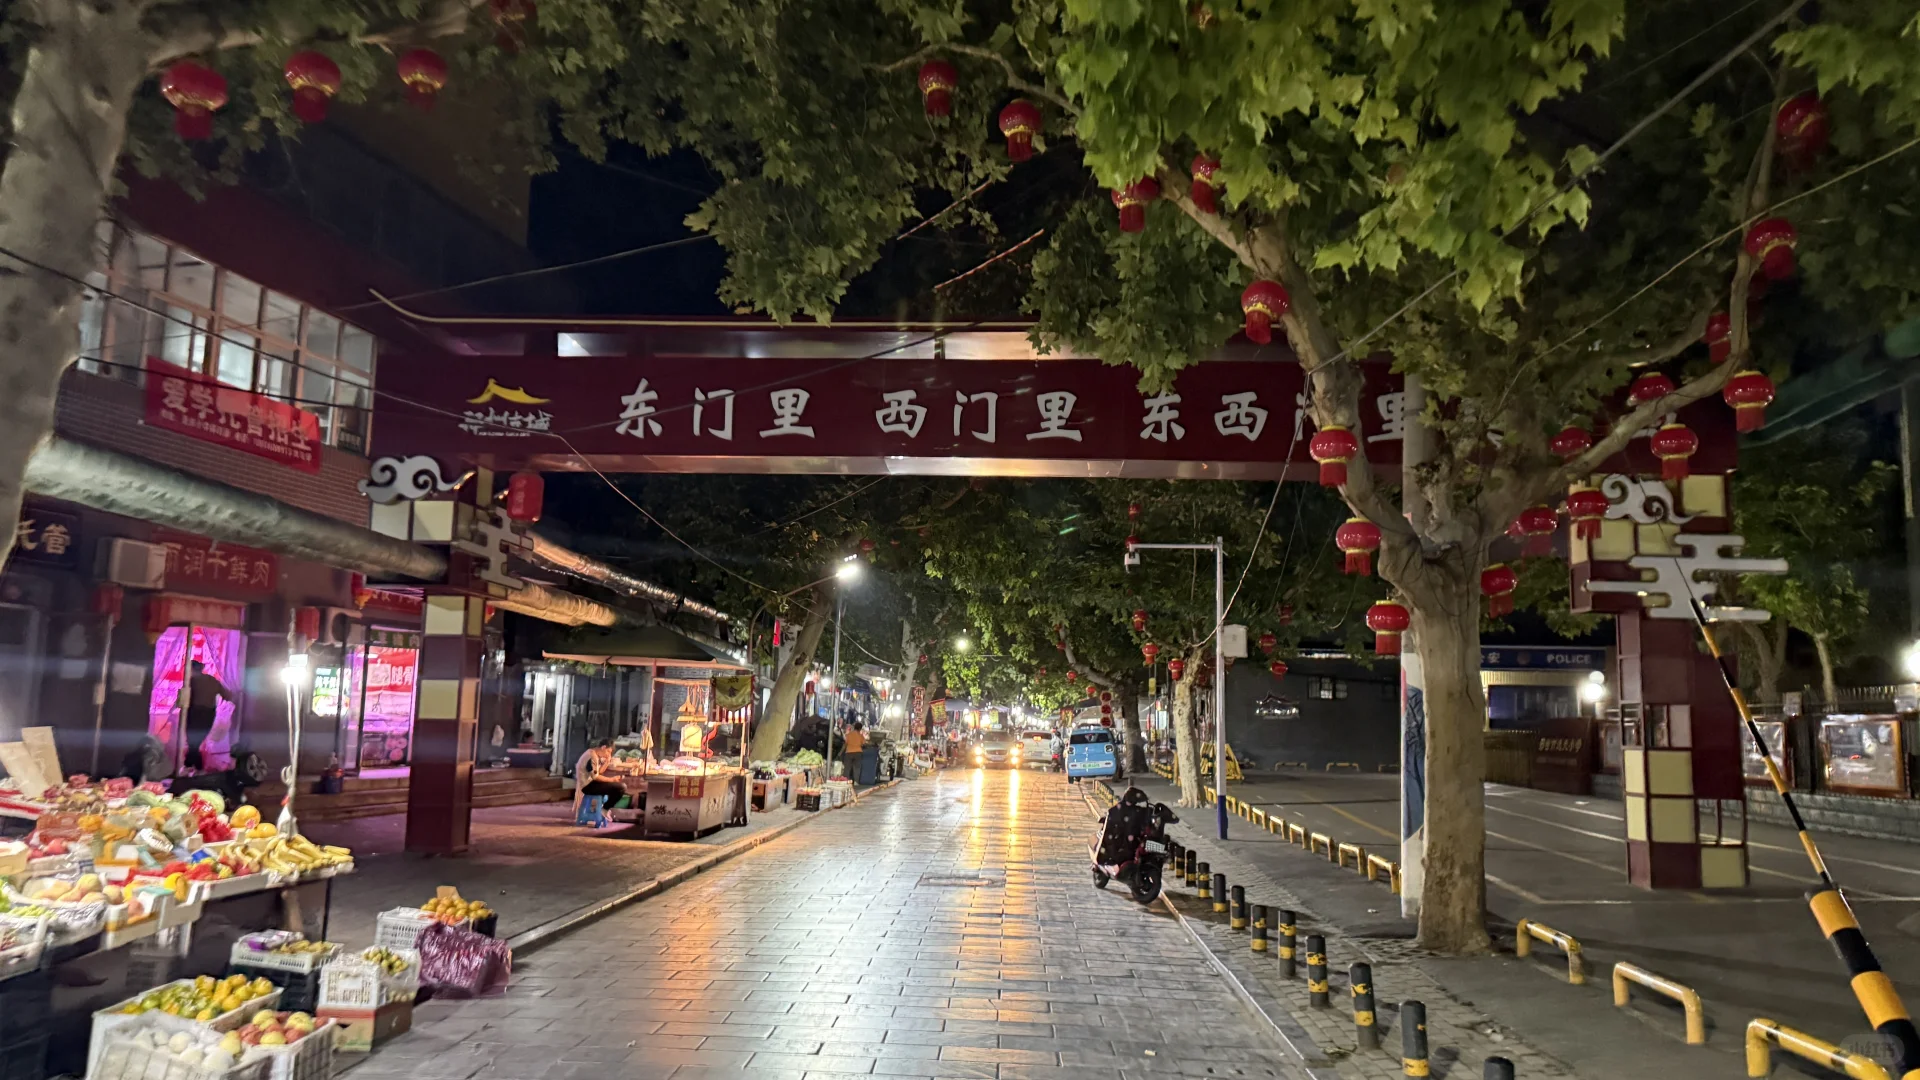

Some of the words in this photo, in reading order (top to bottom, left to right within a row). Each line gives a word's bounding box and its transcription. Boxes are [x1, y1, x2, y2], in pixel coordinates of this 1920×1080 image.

[614, 377, 816, 441] 东门里
[875, 389, 1083, 443] 西门里
[1546, 653, 1592, 665] POLICE
